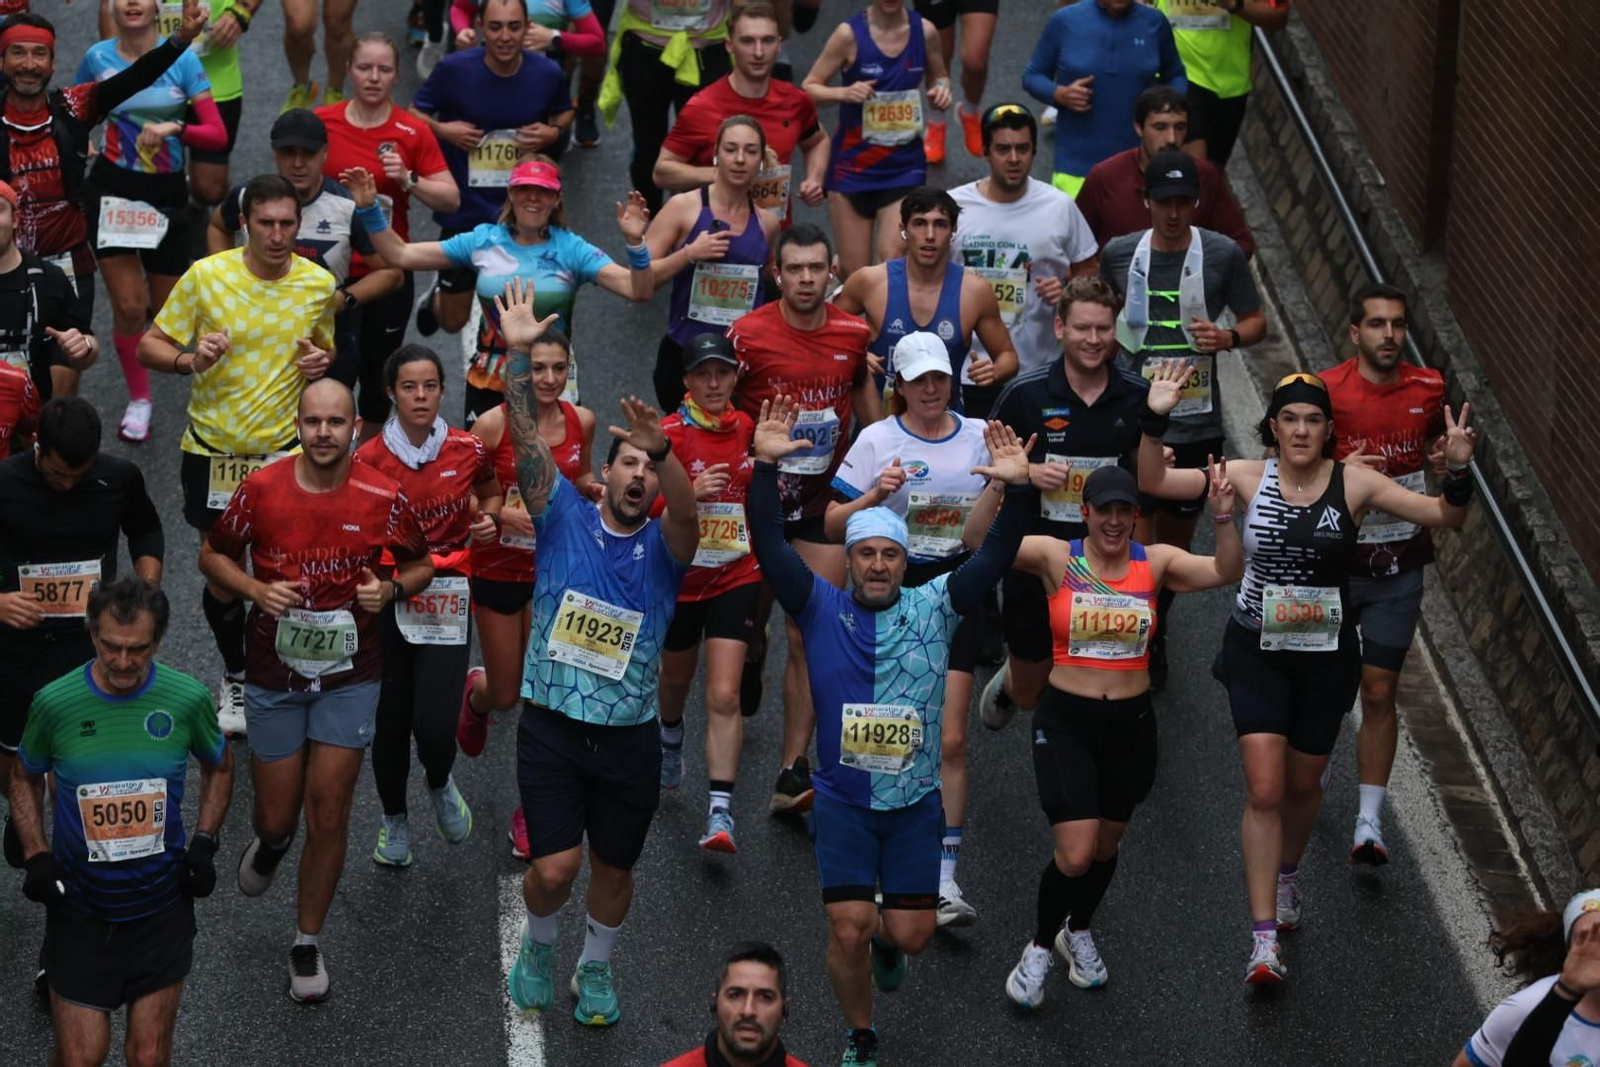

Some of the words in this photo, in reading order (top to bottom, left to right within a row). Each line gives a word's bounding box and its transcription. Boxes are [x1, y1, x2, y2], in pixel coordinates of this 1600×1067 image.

[869, 104, 913, 122] 12639
[107, 210, 157, 226] 15356
[997, 241, 1015, 250] CON
[1017, 243, 1029, 251] LA
[700, 277, 749, 299] 10275
[342, 523, 361, 532] HOKA
[34, 580, 84, 603] 5877
[565, 610, 624, 647] 11923
[1079, 611, 1138, 634] 11192
[290, 627, 338, 650] 7727
[849, 722, 910, 745] 11928
[93, 799, 148, 827] 5050
